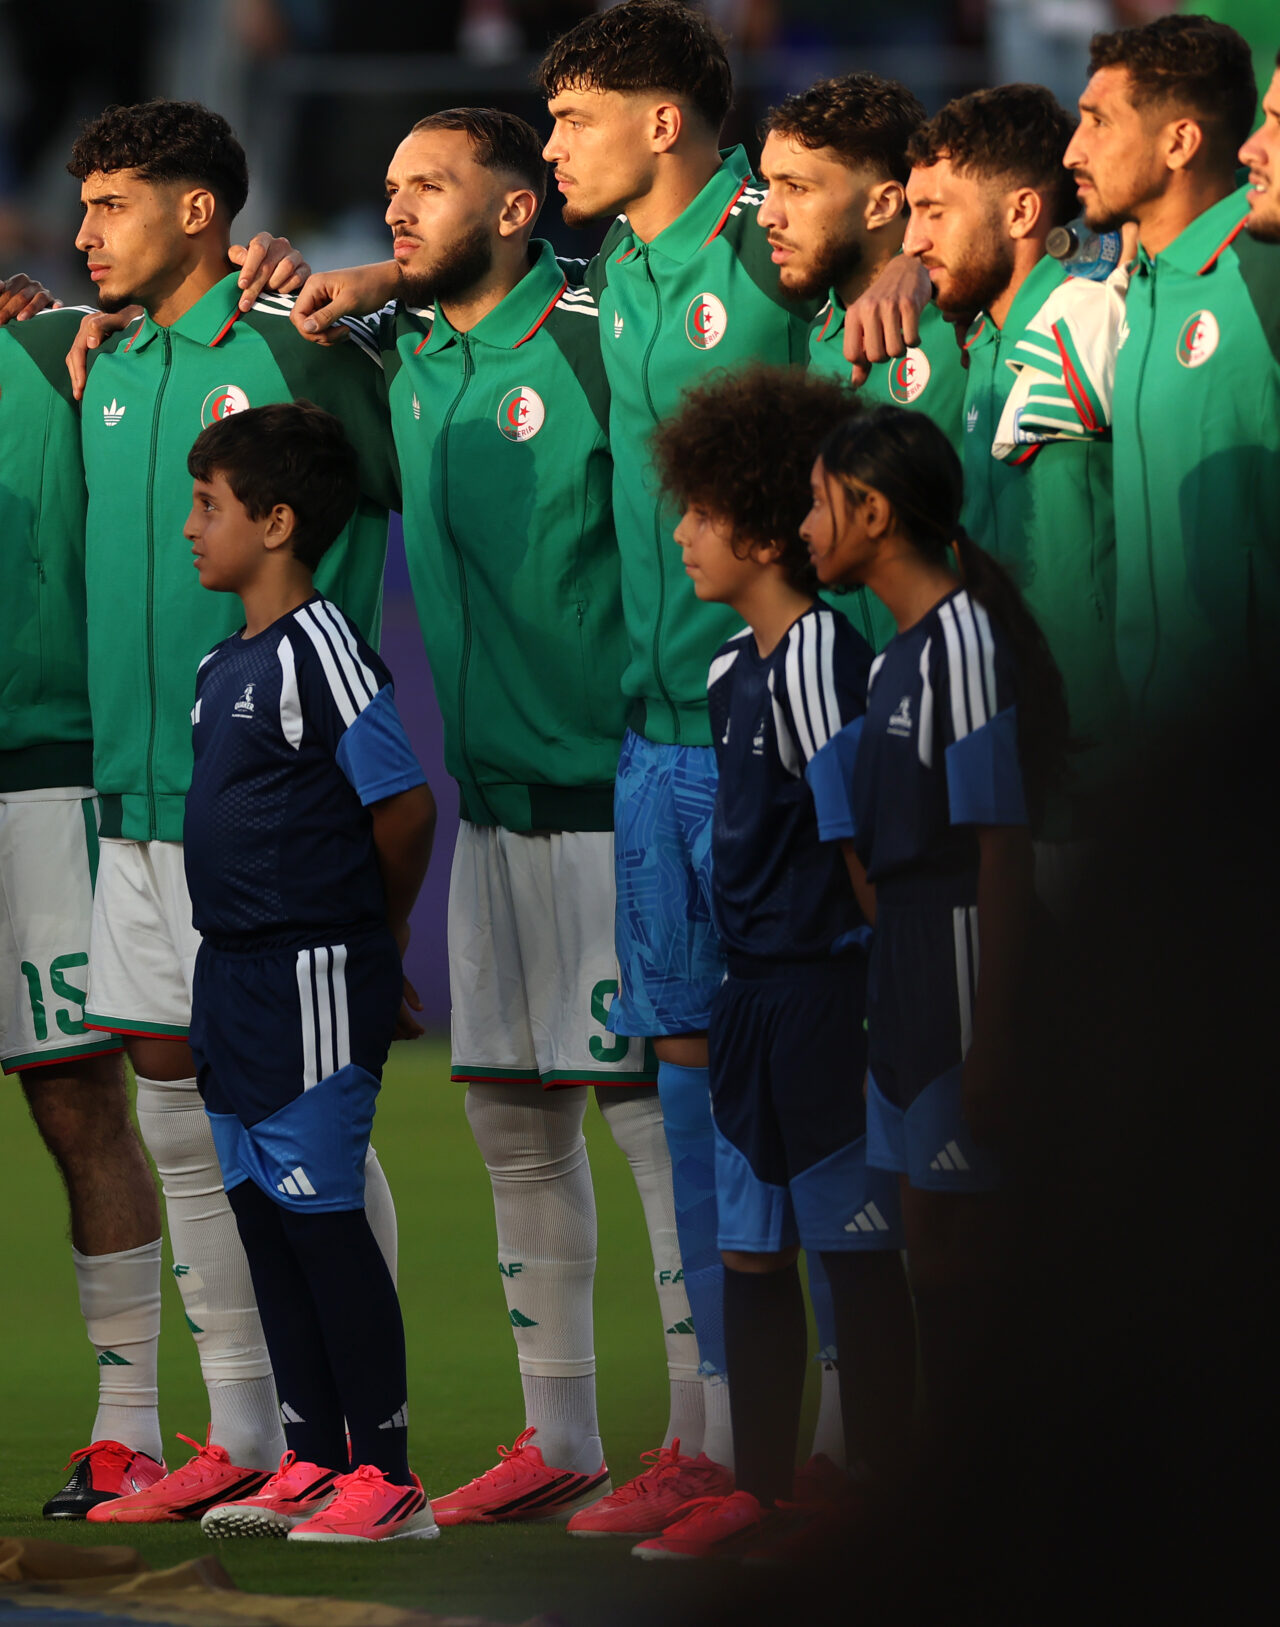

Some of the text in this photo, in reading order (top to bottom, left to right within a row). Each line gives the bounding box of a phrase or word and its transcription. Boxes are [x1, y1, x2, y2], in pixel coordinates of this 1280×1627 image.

[20, 952, 89, 1041] 15
[499, 1262, 523, 1278] AF
[660, 1269, 684, 1285] FA
